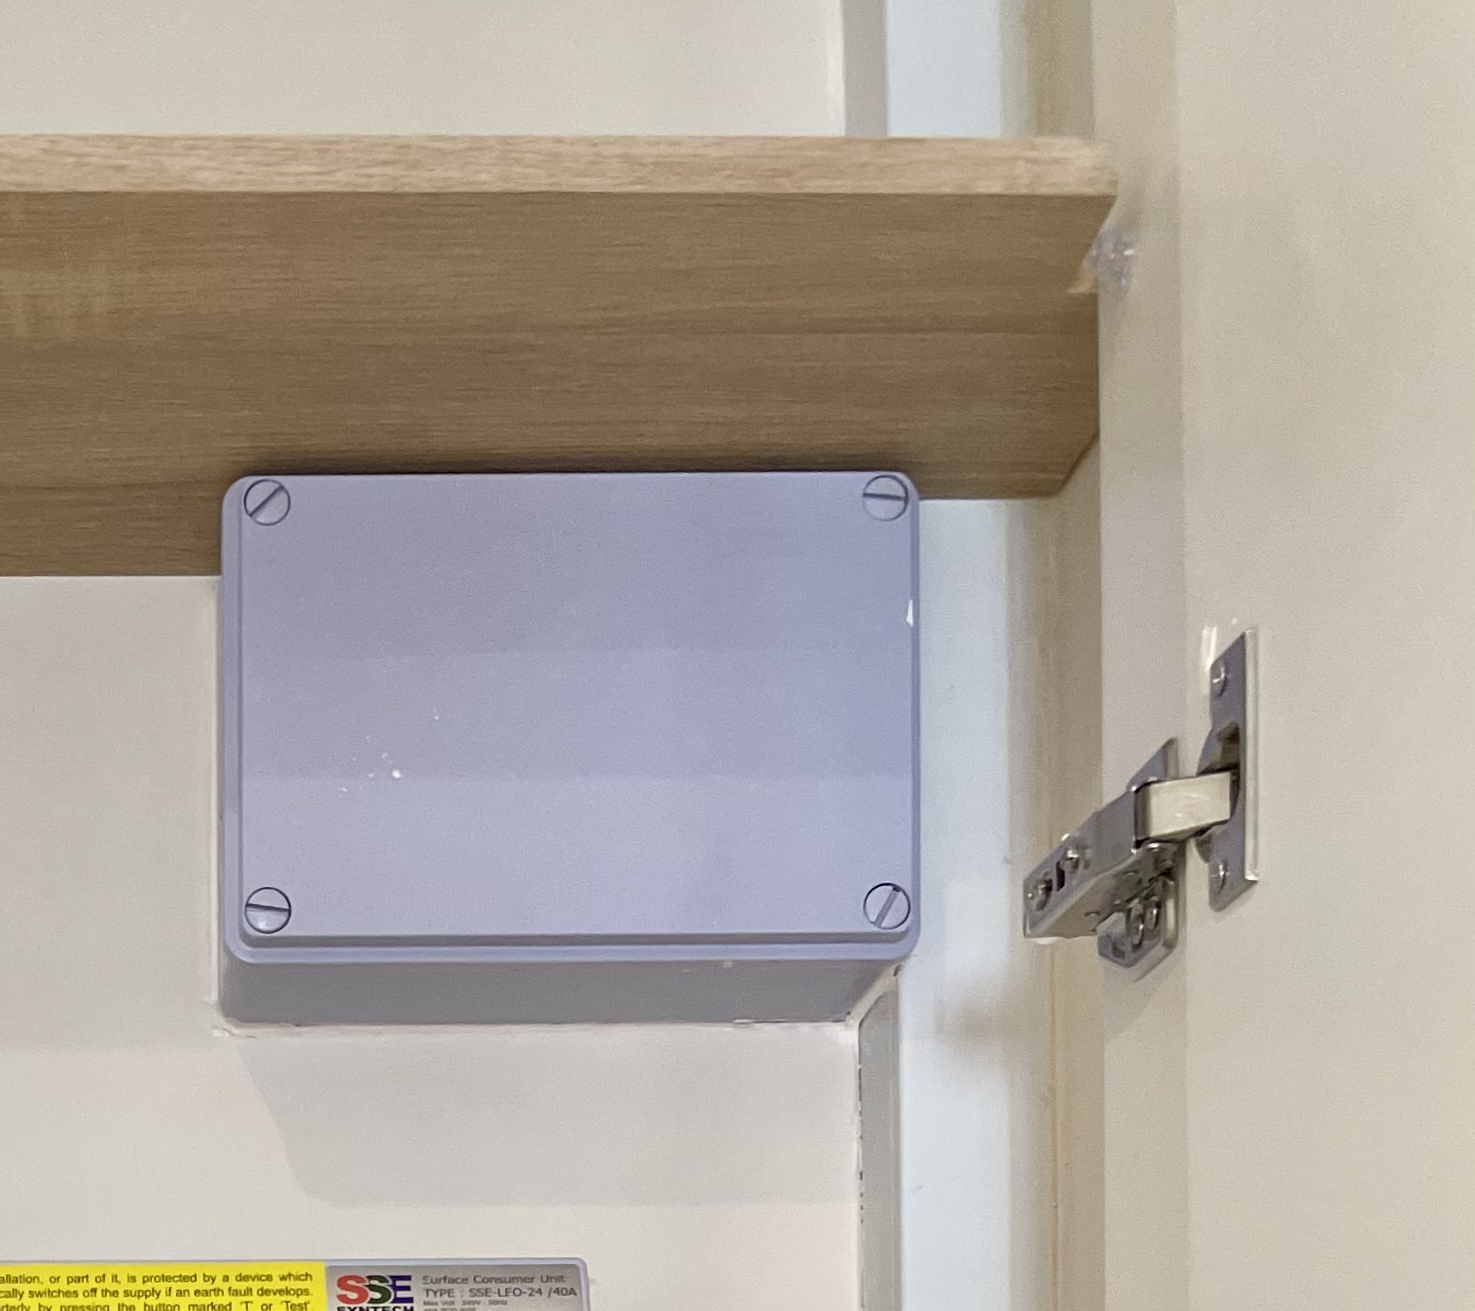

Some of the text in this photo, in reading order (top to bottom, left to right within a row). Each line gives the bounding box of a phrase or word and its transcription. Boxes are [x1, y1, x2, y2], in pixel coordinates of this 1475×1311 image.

[49, 1276, 60, 1284] or
[66, 1274, 89, 1286] part
[95, 1274, 106, 1283] of
[127, 1274, 136, 1283] is
[142, 1273, 197, 1285] protected
[203, 1273, 217, 1285] by
[222, 1274, 230, 1283] a
[235, 1272, 273, 1283] device
[278, 1272, 313, 1282] which
[422, 1275, 566, 1285] Surface Consumer Unit
[28, 1288, 79, 1298] switches
[83, 1288, 97, 1298] off
[101, 1288, 119, 1298] the
[123, 1287, 161, 1300] supply
[165, 1287, 172, 1297] if
[175, 1289, 190, 1297] an
[194, 1287, 224, 1297] earth
[228, 1287, 253, 1297] fault
[336, 1275, 414, 1305] SSE
[424, 1288, 455, 1298] TYPE
[468, 1287, 543, 1298] SSE-LFO-24
[547, 1287, 578, 1298] /40A
[188, 1301, 232, 1311] marked
[261, 1303, 273, 1311] or
